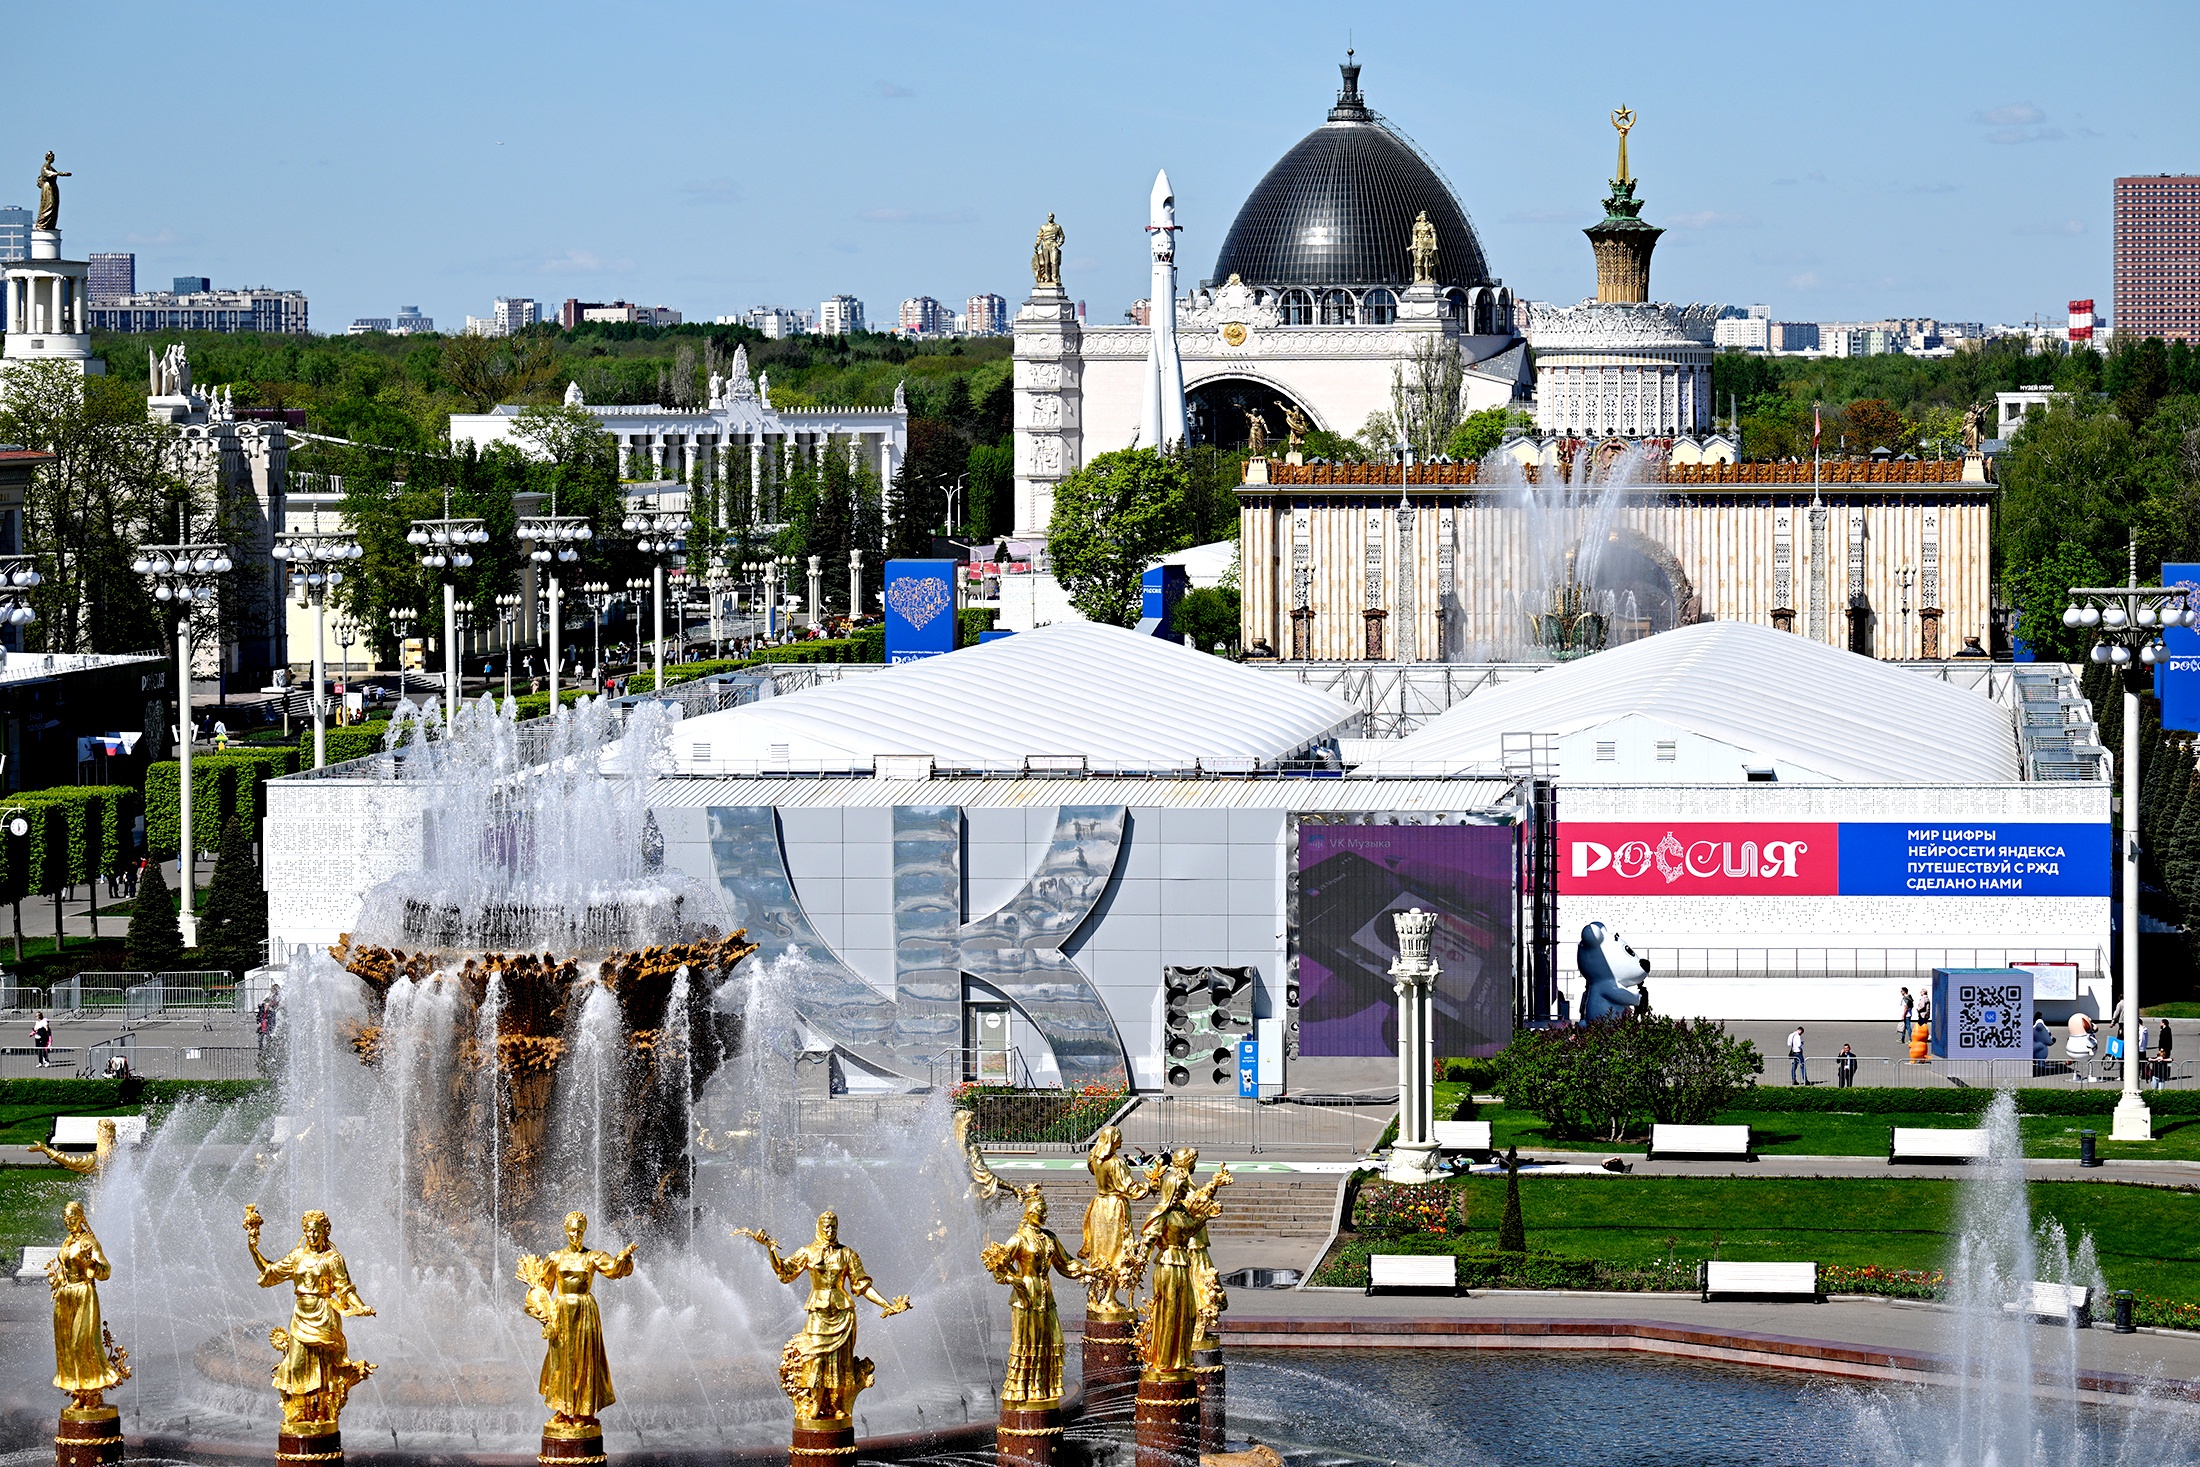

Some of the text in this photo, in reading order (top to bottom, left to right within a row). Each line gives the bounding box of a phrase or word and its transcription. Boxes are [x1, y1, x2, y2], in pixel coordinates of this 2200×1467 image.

[1907, 830, 1996, 842] МИР ЦИФРЫ
[1329, 839, 1391, 850] VK Музыка
[1908, 843, 2066, 859] НЕЙРОСЕТИ ЯНДЕКСА
[1571, 831, 1808, 884] РОССИЯ
[1907, 859, 2059, 875] ПУТЕШЕСТВУЙ С РЖД
[1906, 878, 2022, 890] СДЕЛАНО НАМИ
